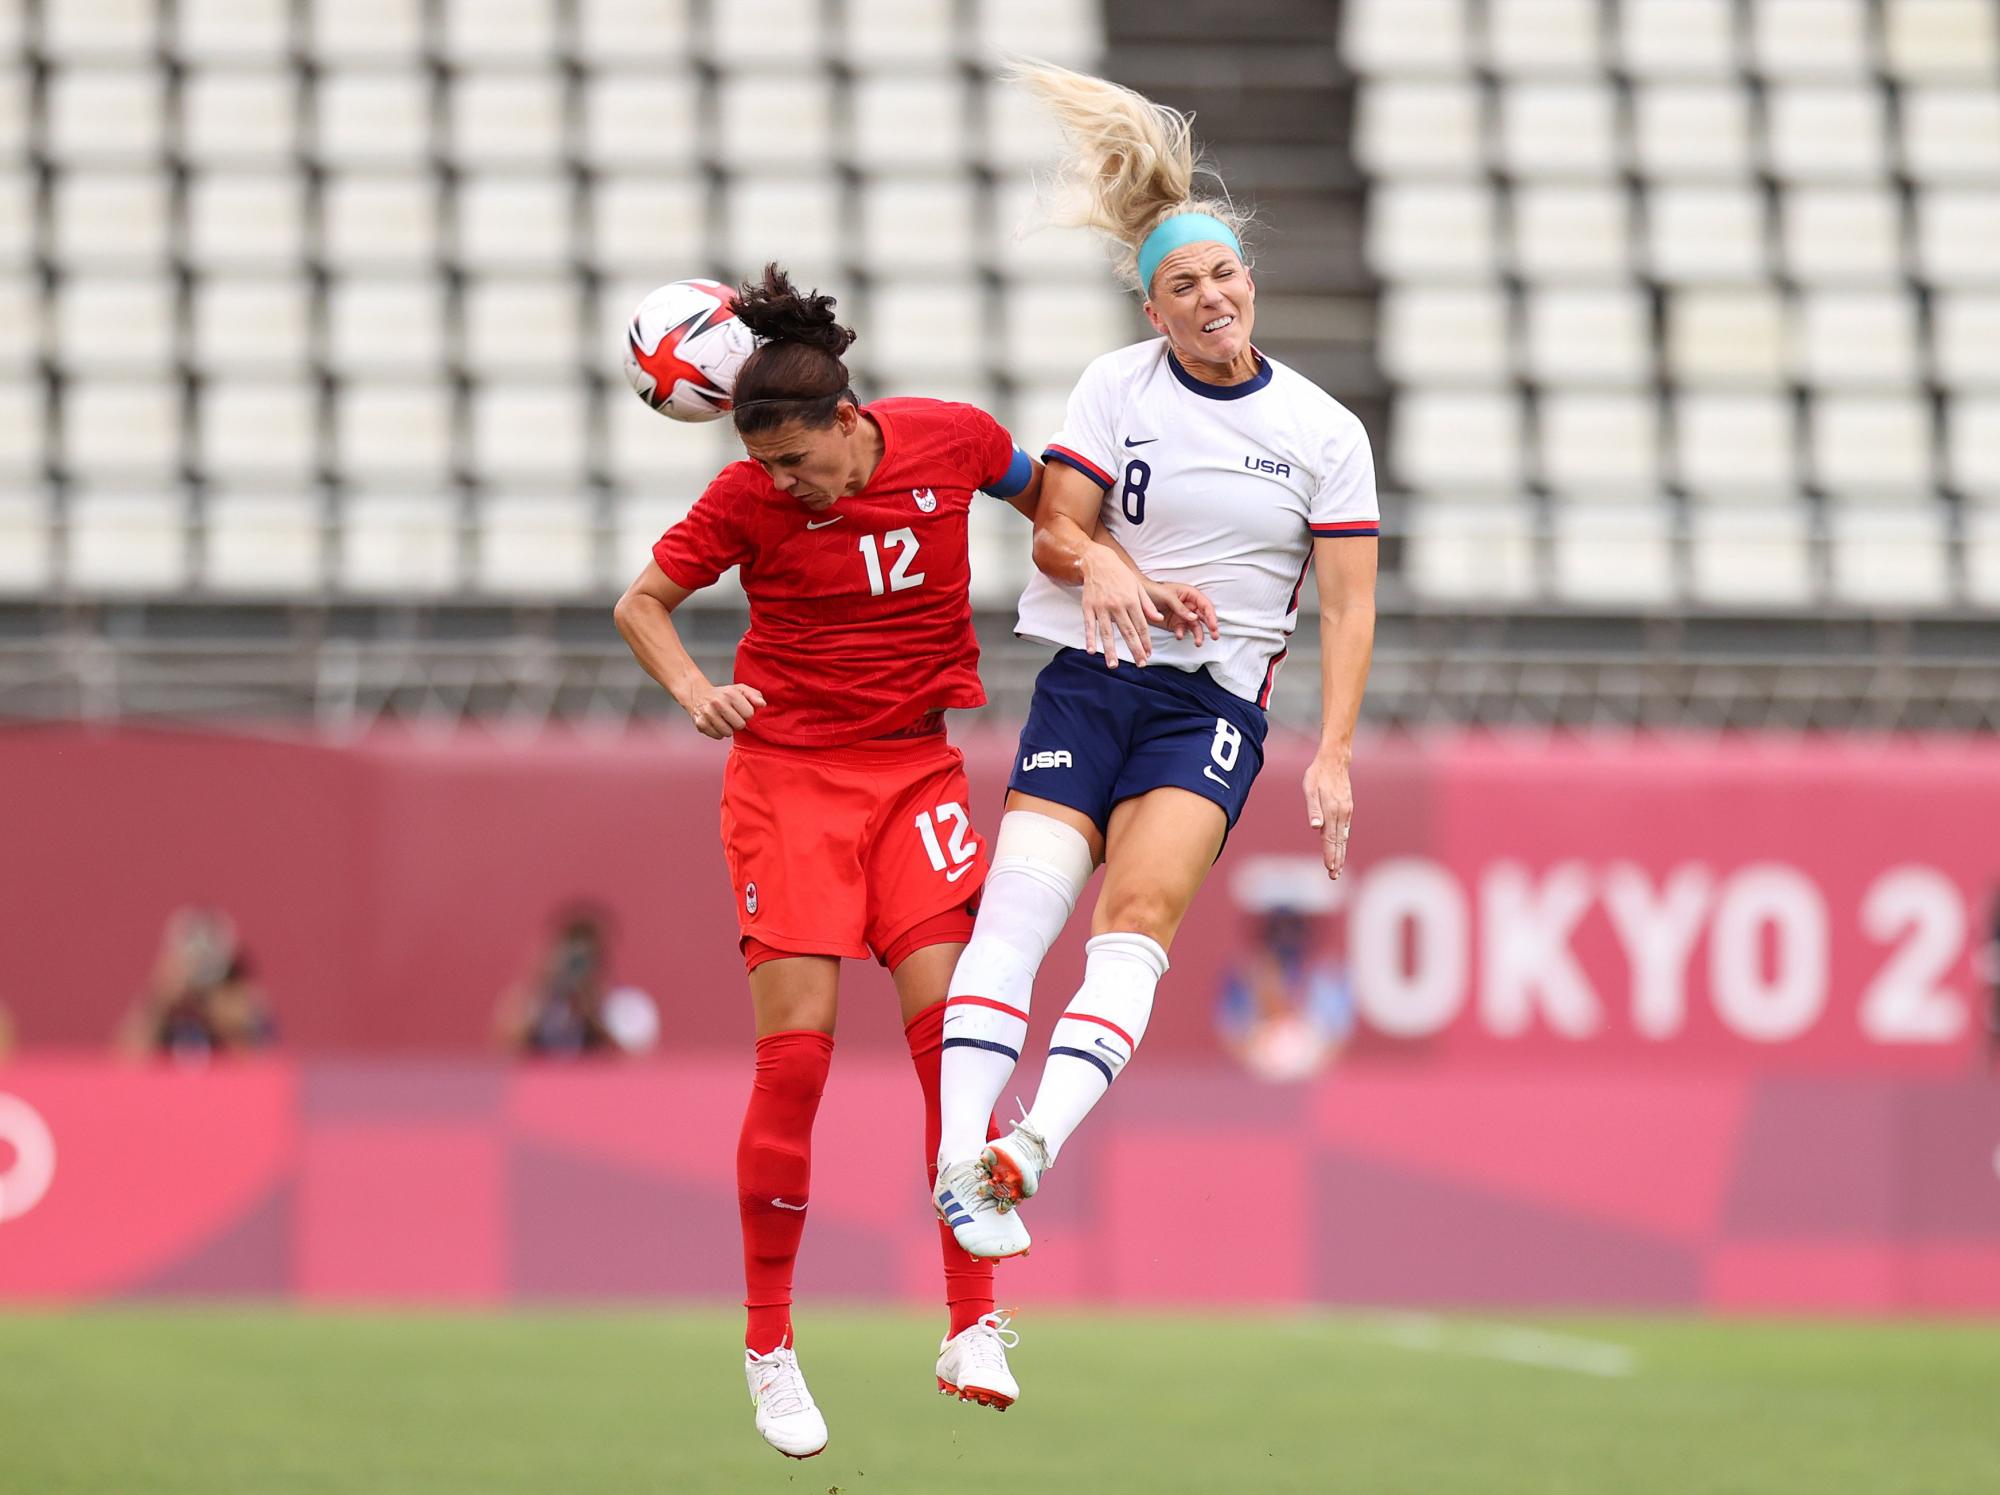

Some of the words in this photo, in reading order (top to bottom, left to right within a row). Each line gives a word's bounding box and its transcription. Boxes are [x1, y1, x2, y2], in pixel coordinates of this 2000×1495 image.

[1121, 458, 1152, 526] 8
[1244, 455, 1291, 480] USA
[858, 526, 926, 597] 12
[1022, 750, 1073, 772] USA
[1210, 717, 1242, 772] 8
[915, 801, 978, 872] 12
